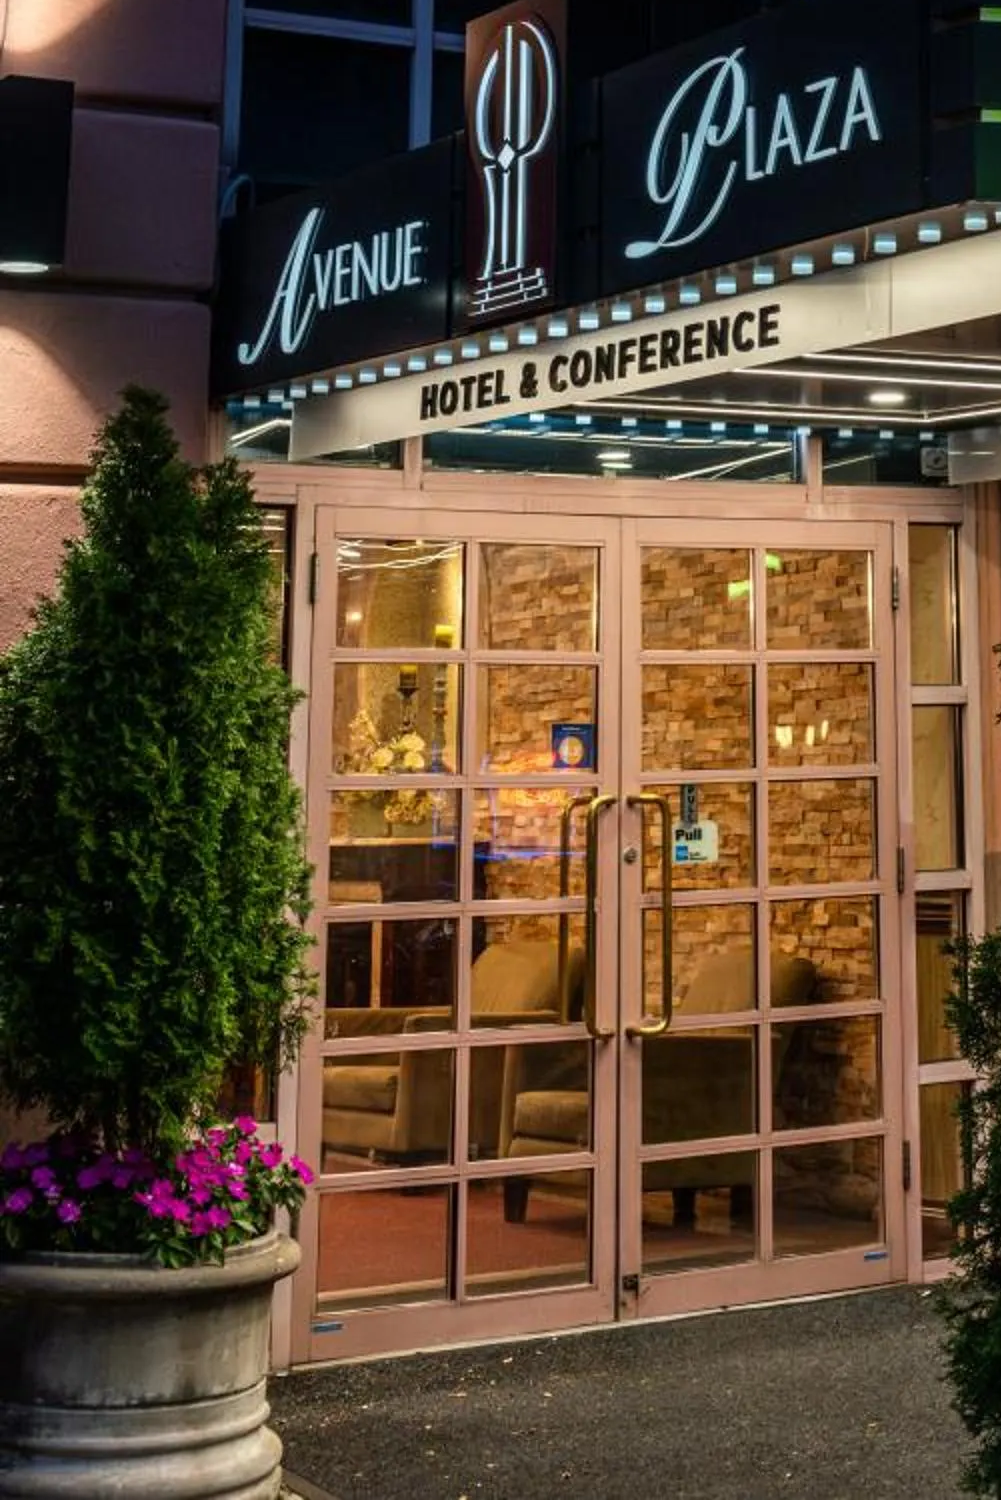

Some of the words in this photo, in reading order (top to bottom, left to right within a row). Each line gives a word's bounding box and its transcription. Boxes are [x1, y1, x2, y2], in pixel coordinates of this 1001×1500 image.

[624, 46, 882, 259] PLAZA
[419, 368, 510, 420] HOTEL
[518, 361, 538, 398] &
[548, 303, 781, 393] CONFERENCE
[675, 828, 702, 841] Pull
